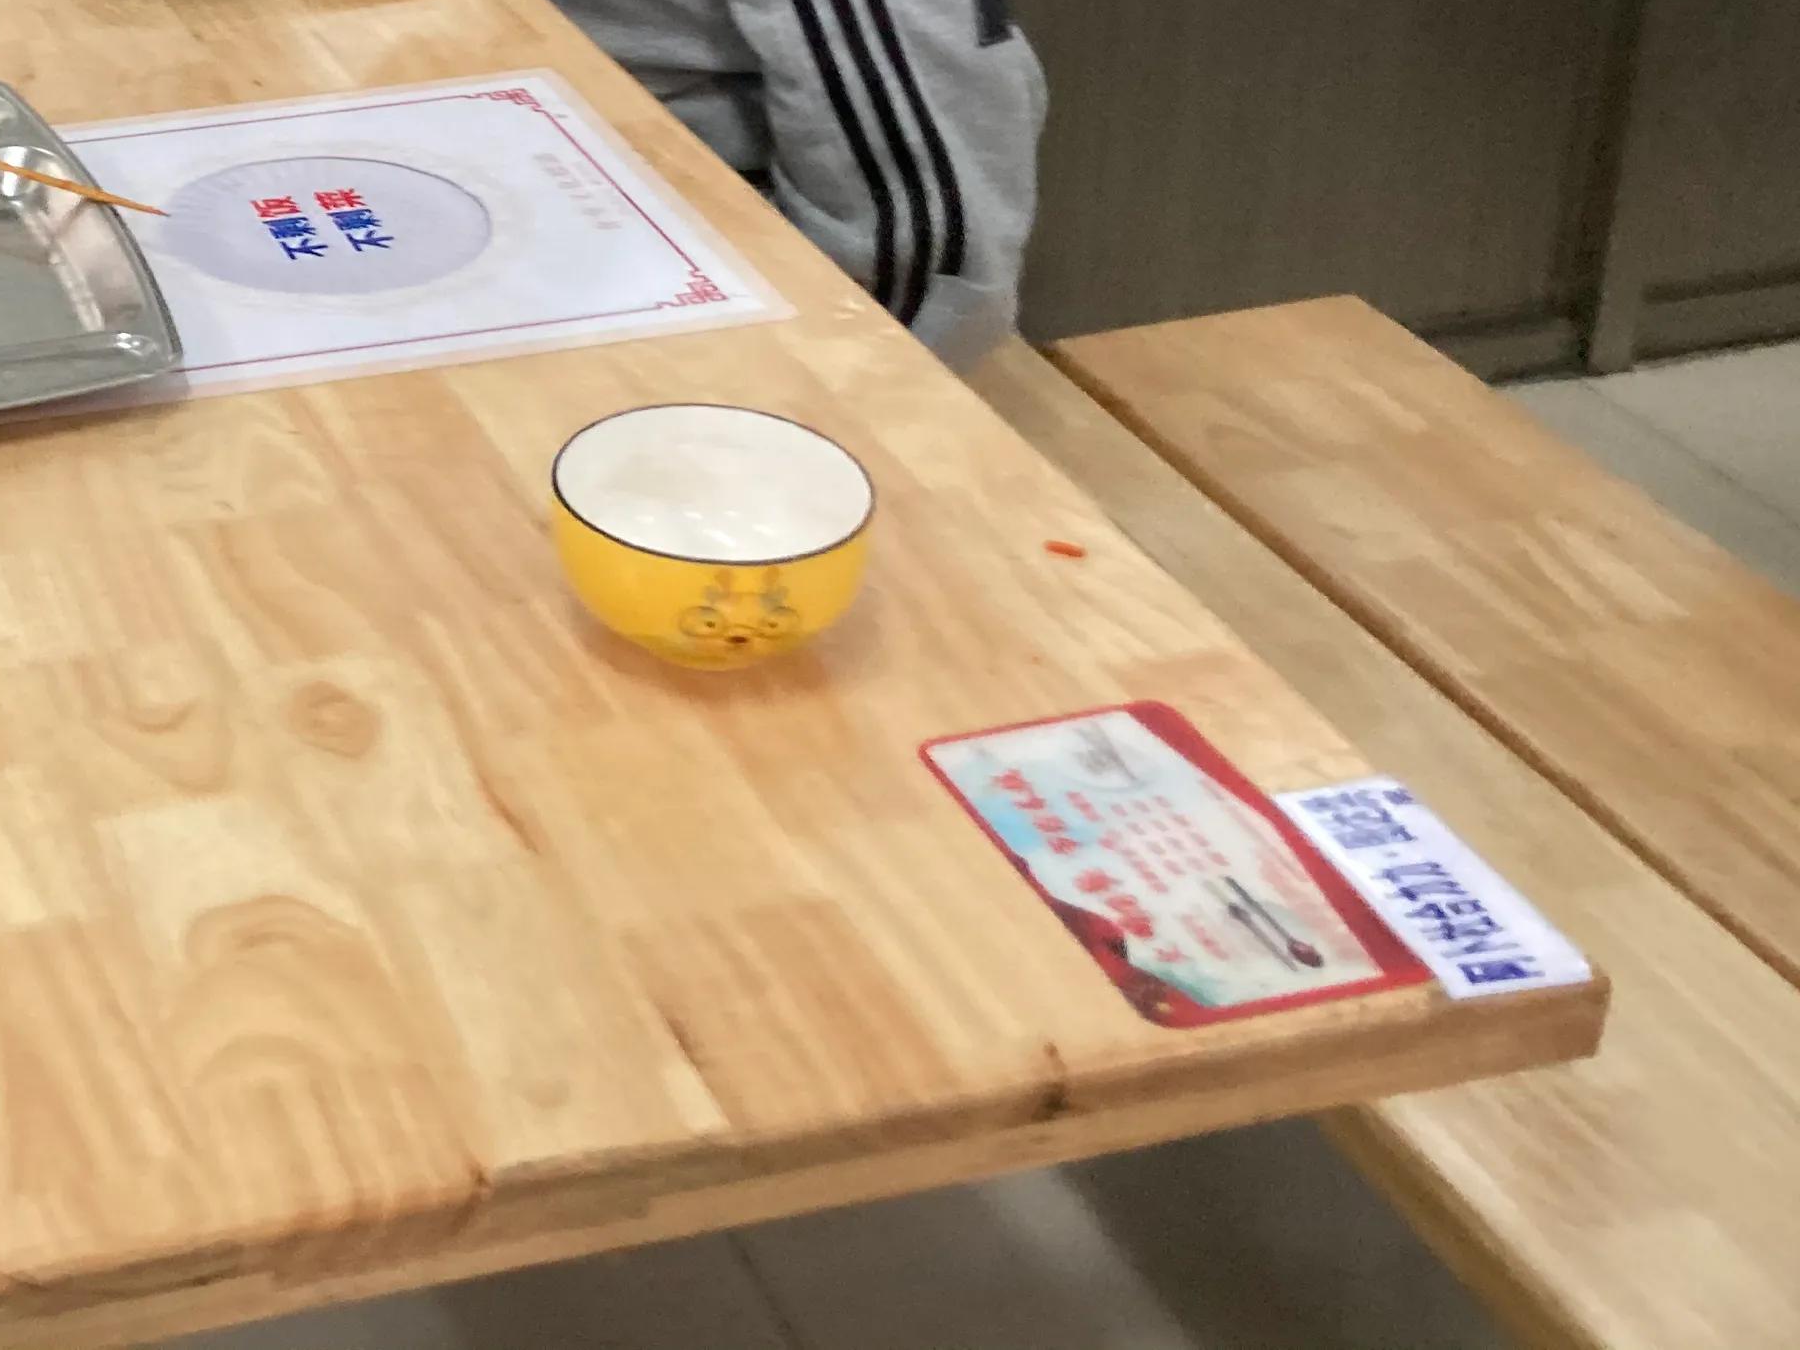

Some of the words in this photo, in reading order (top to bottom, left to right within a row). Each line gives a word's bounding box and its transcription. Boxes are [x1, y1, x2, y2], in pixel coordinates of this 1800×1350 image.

[249, 195, 328, 260] 不剩饭
[314, 187, 395, 254] 不剩菜
